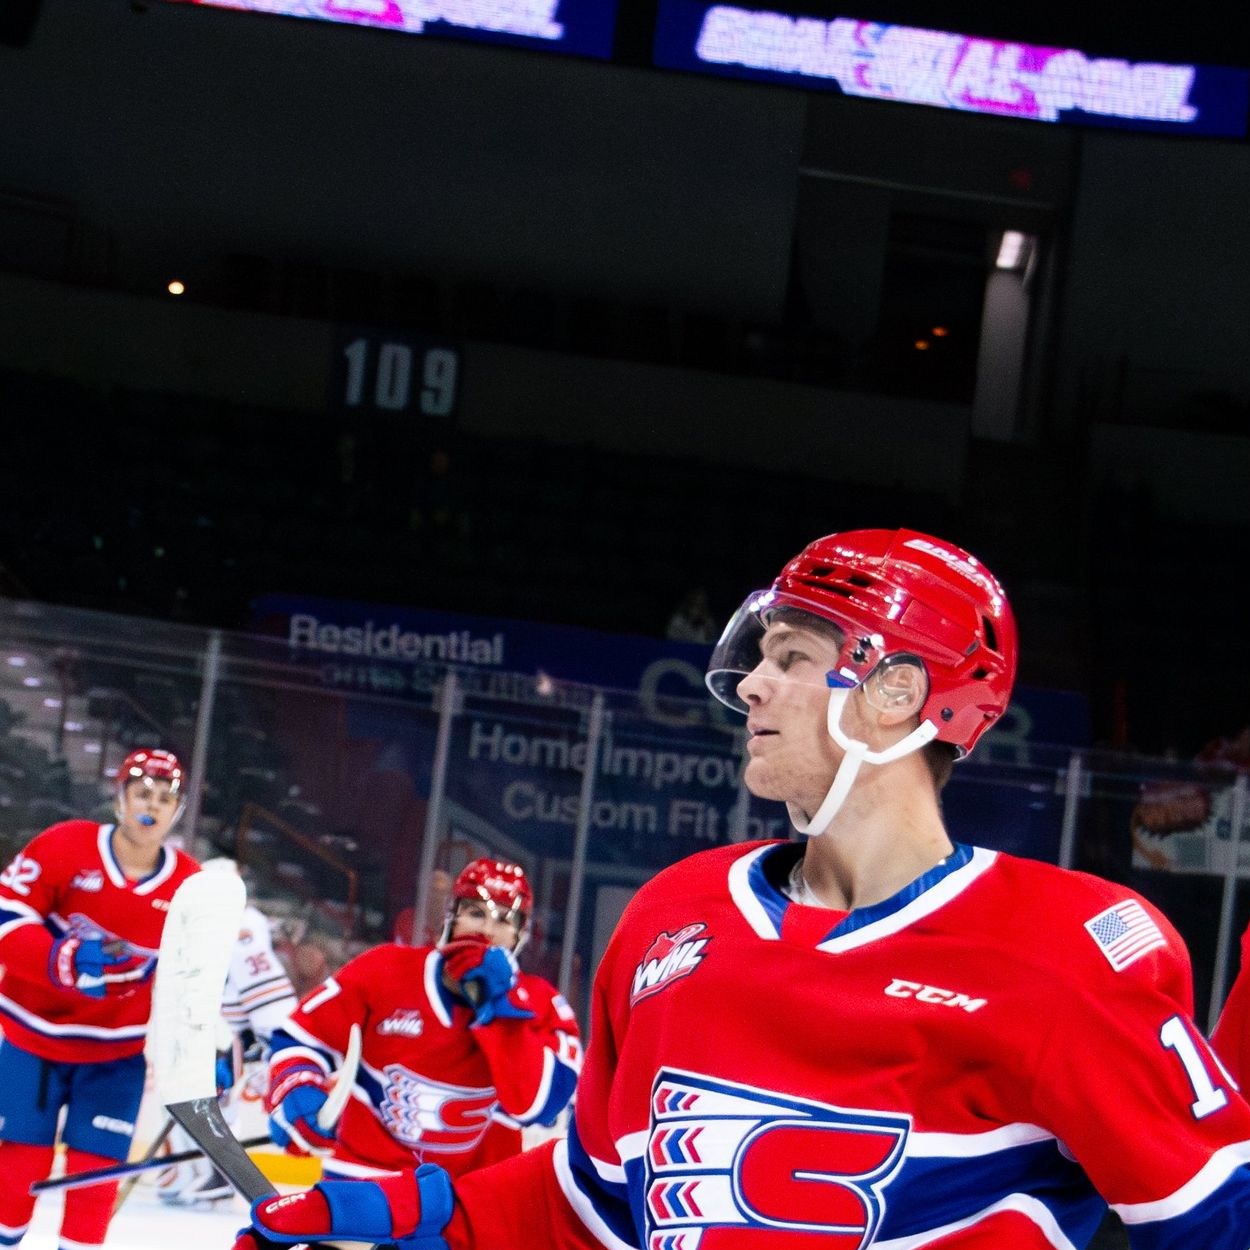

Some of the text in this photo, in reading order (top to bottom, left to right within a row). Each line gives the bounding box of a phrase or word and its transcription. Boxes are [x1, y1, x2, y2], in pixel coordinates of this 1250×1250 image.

[344, 337, 458, 416] 109
[288, 614, 505, 664] Residential
[503, 781, 657, 834] Cusom
[667, 800, 719, 842] Fit
[634, 938, 711, 998] WHL
[883, 978, 989, 1013] CCM
[265, 1193, 307, 1214] CCM
